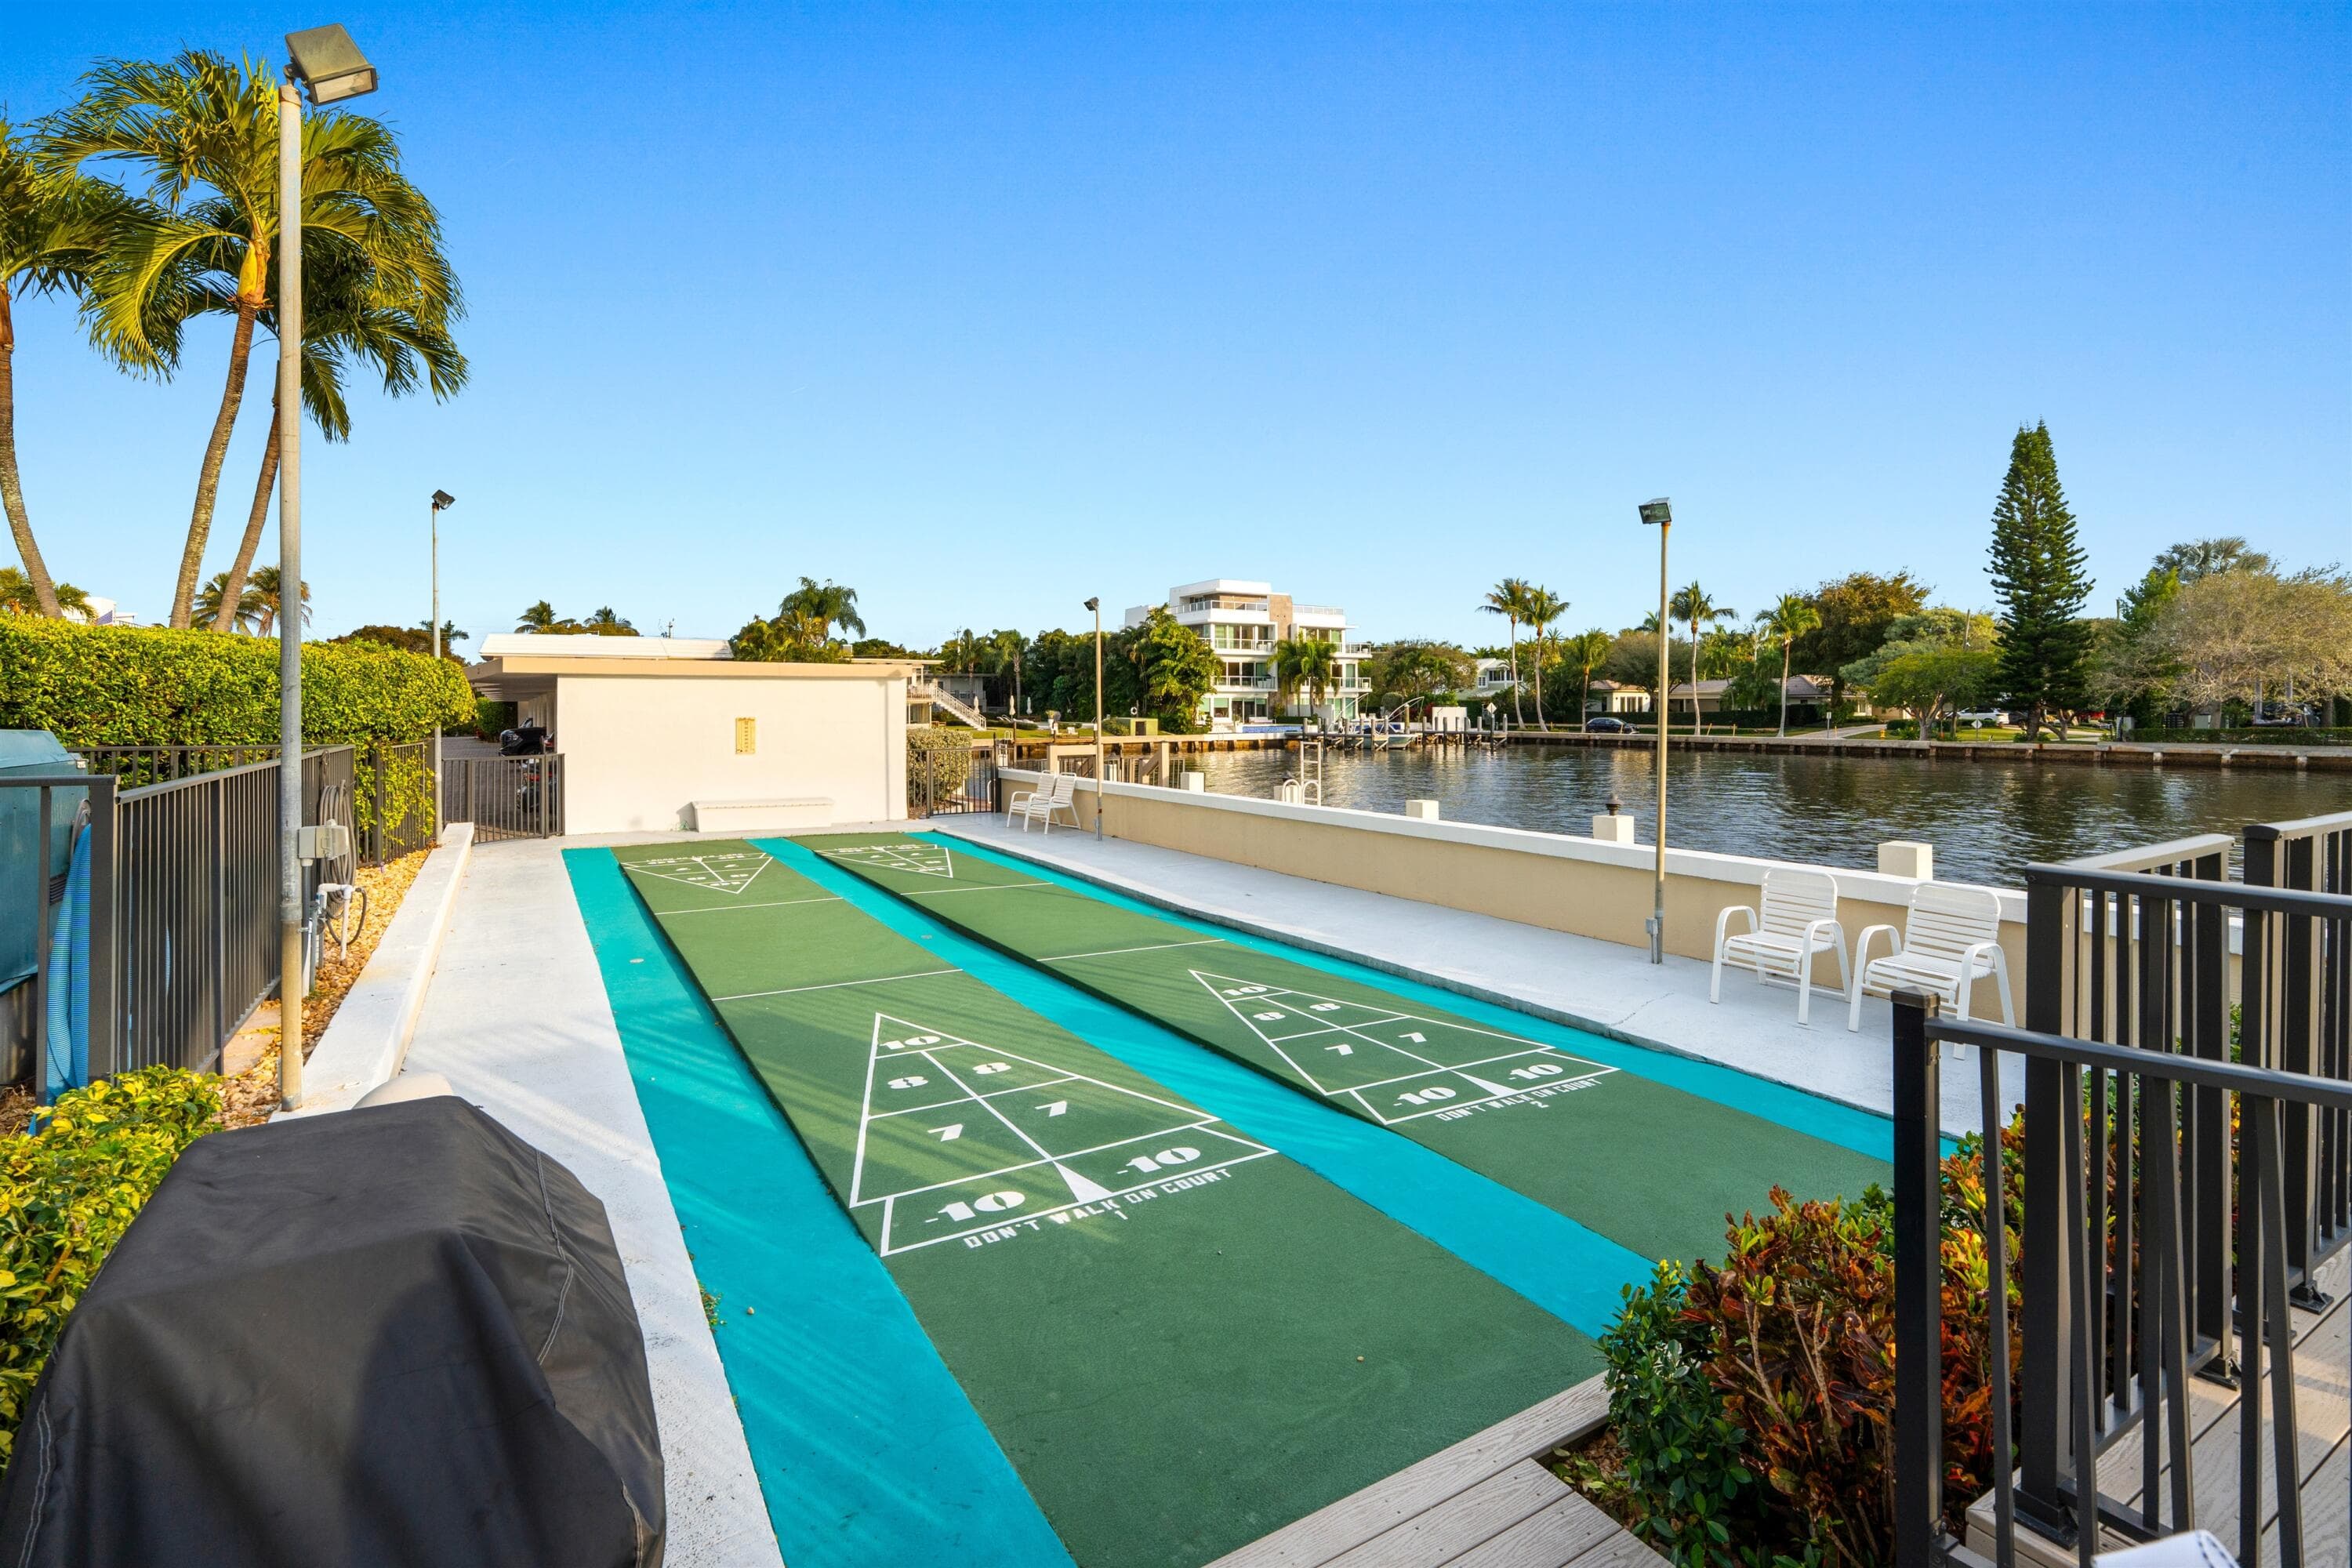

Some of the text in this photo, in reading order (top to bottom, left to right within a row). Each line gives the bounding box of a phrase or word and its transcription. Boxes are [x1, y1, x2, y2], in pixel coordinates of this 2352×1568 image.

[1221, 985, 1267, 996] 10
[1309, 1003, 1341, 1012] 8
[1253, 1011, 1286, 1021] 8
[879, 1035, 941, 1050] 10
[1398, 1032, 1428, 1044] 7
[1324, 1044, 1354, 1056] 7
[972, 1062, 1012, 1075] 8
[1508, 1064, 1564, 1081] -10
[887, 1076, 929, 1090] 8
[1392, 1087, 1457, 1106] -10
[1434, 1077, 1603, 1122] DON'T WALK ON COURT
[1034, 1099, 1069, 1118] 7
[927, 1123, 964, 1142] 7
[1116, 1146, 1201, 1174] -10
[925, 1191, 1025, 1223] -10
[964, 1168, 1232, 1248] DON'T WALK ON COURT
